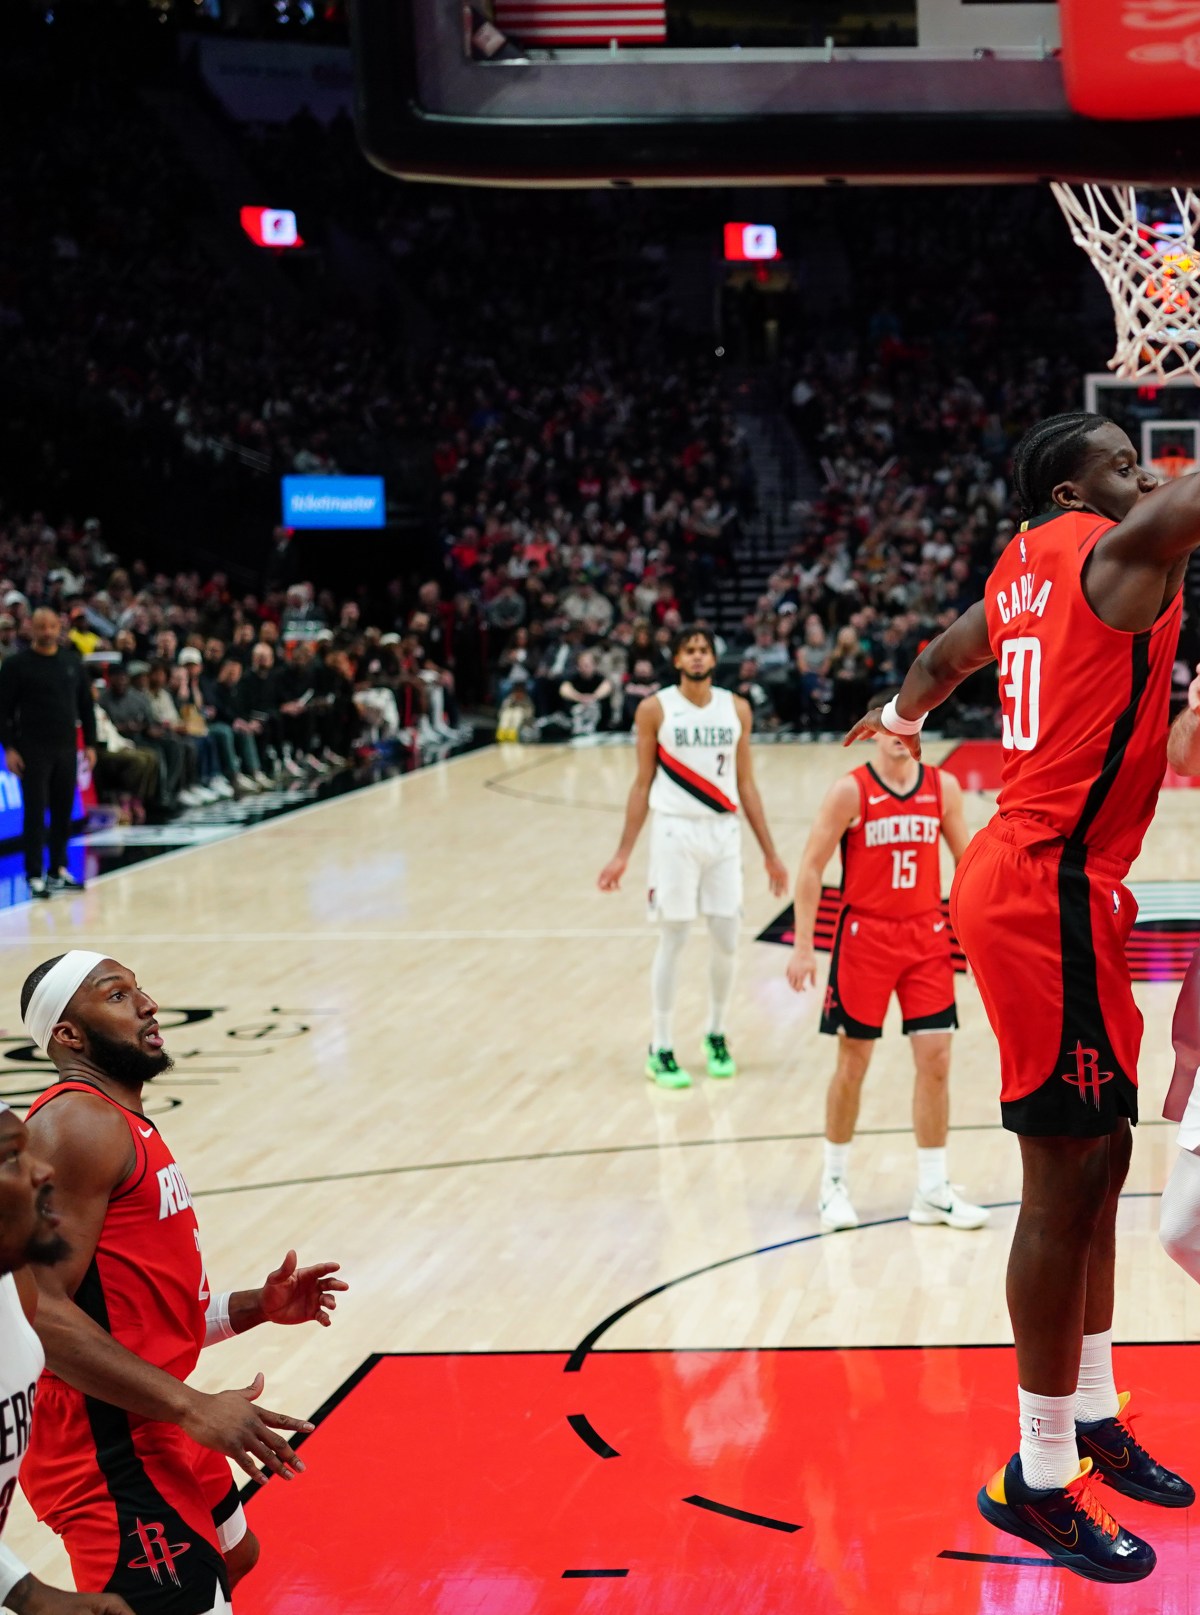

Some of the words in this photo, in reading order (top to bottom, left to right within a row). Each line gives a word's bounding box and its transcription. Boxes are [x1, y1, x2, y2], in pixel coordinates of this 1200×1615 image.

[997, 573, 1052, 624] CAPEA
[1001, 637, 1041, 751] 30
[675, 727, 733, 746] BLAZERS
[865, 814, 940, 847] ROCKETS
[891, 850, 917, 889] 15
